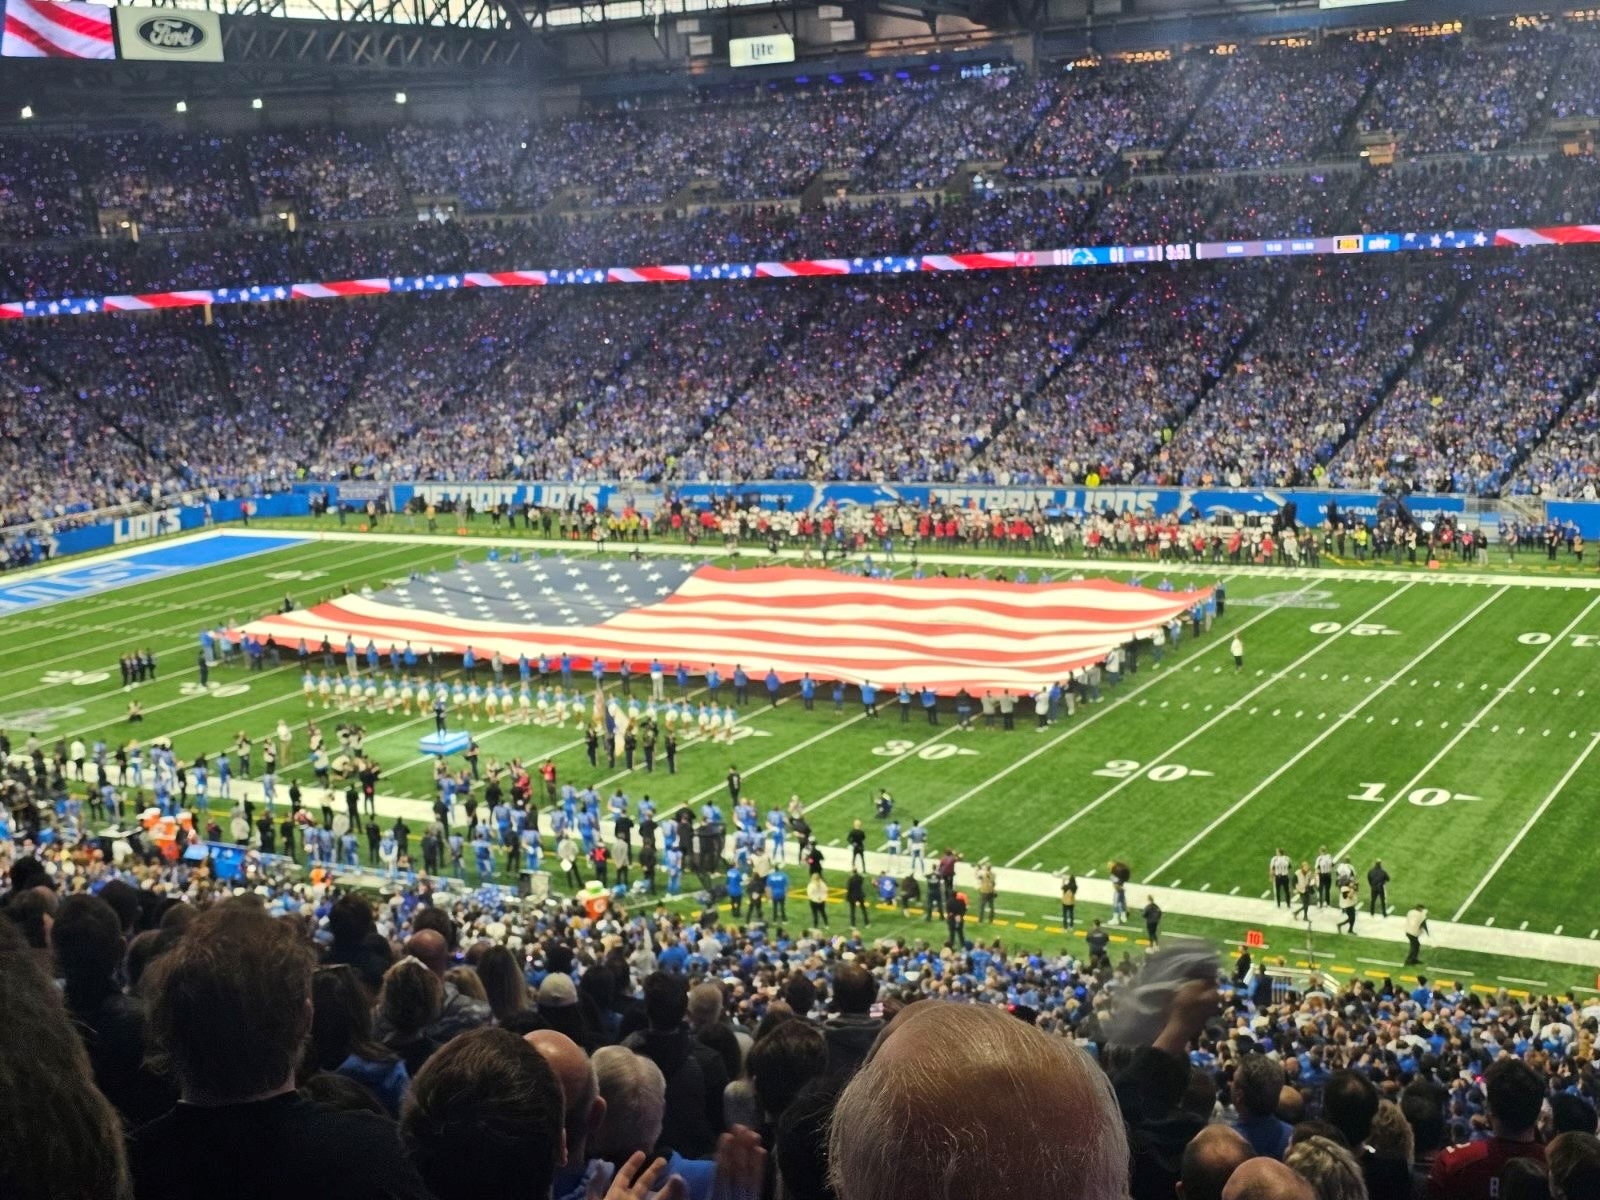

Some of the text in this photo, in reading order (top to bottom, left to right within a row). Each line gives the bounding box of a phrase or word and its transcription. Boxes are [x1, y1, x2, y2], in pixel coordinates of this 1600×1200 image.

[149, 19, 195, 46] Ford
[751, 43, 774, 60] Lite
[523, 486, 600, 511] LIONS
[1064, 491, 1158, 516] LIONS
[114, 507, 181, 544] LIONS
[872, 740, 957, 759] 30
[1092, 760, 1188, 781] 20
[1348, 782, 1451, 806] 10
[1249, 932, 1260, 945] 10
